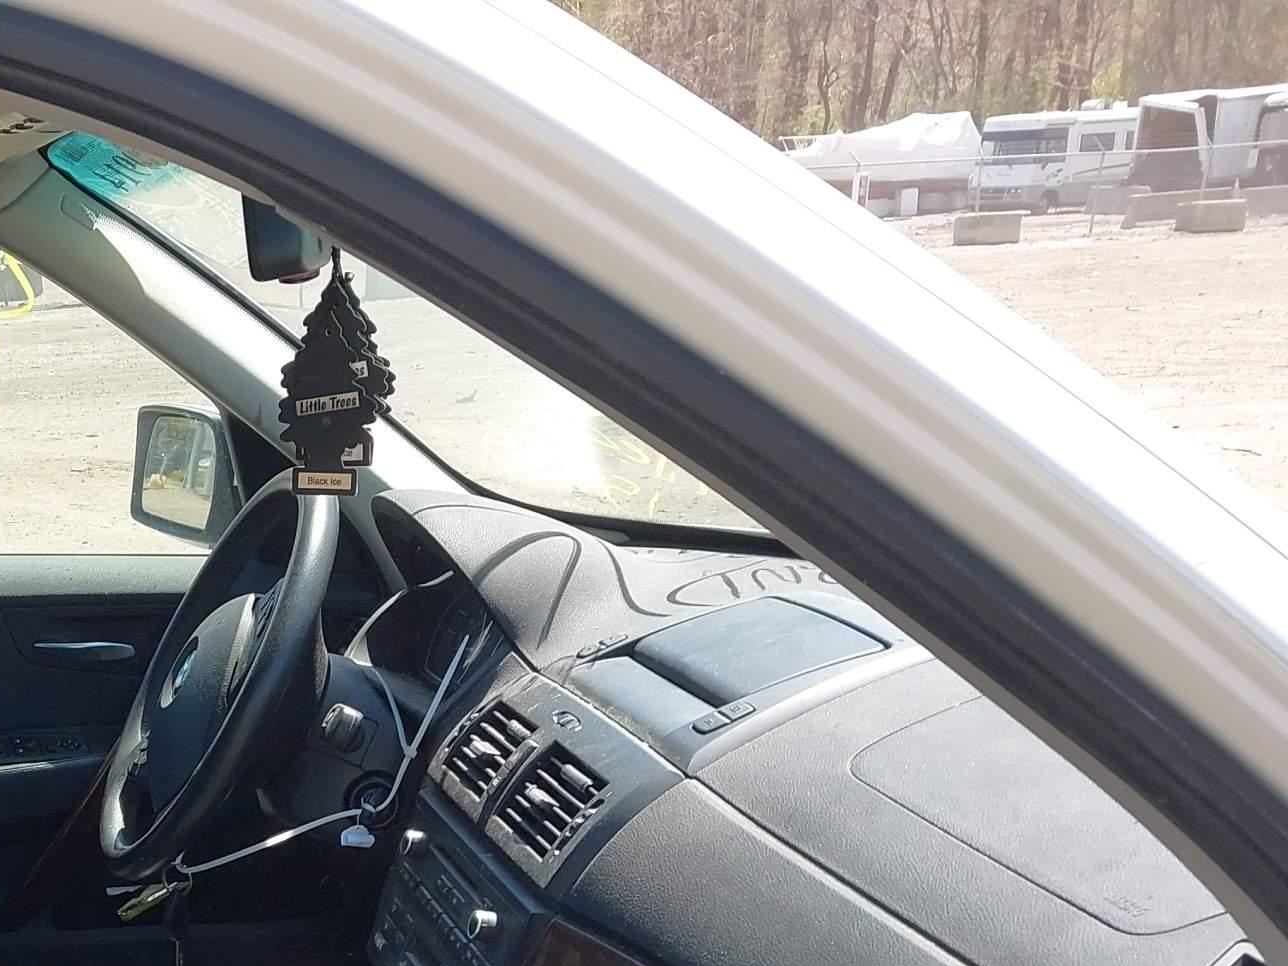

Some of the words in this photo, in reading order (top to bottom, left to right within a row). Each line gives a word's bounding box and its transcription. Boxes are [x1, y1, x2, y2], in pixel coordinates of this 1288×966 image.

[300, 399, 327, 414] Little
[329, 396, 357, 410] Trees
[307, 476, 329, 485] Black
[330, 477, 342, 486] Ice
